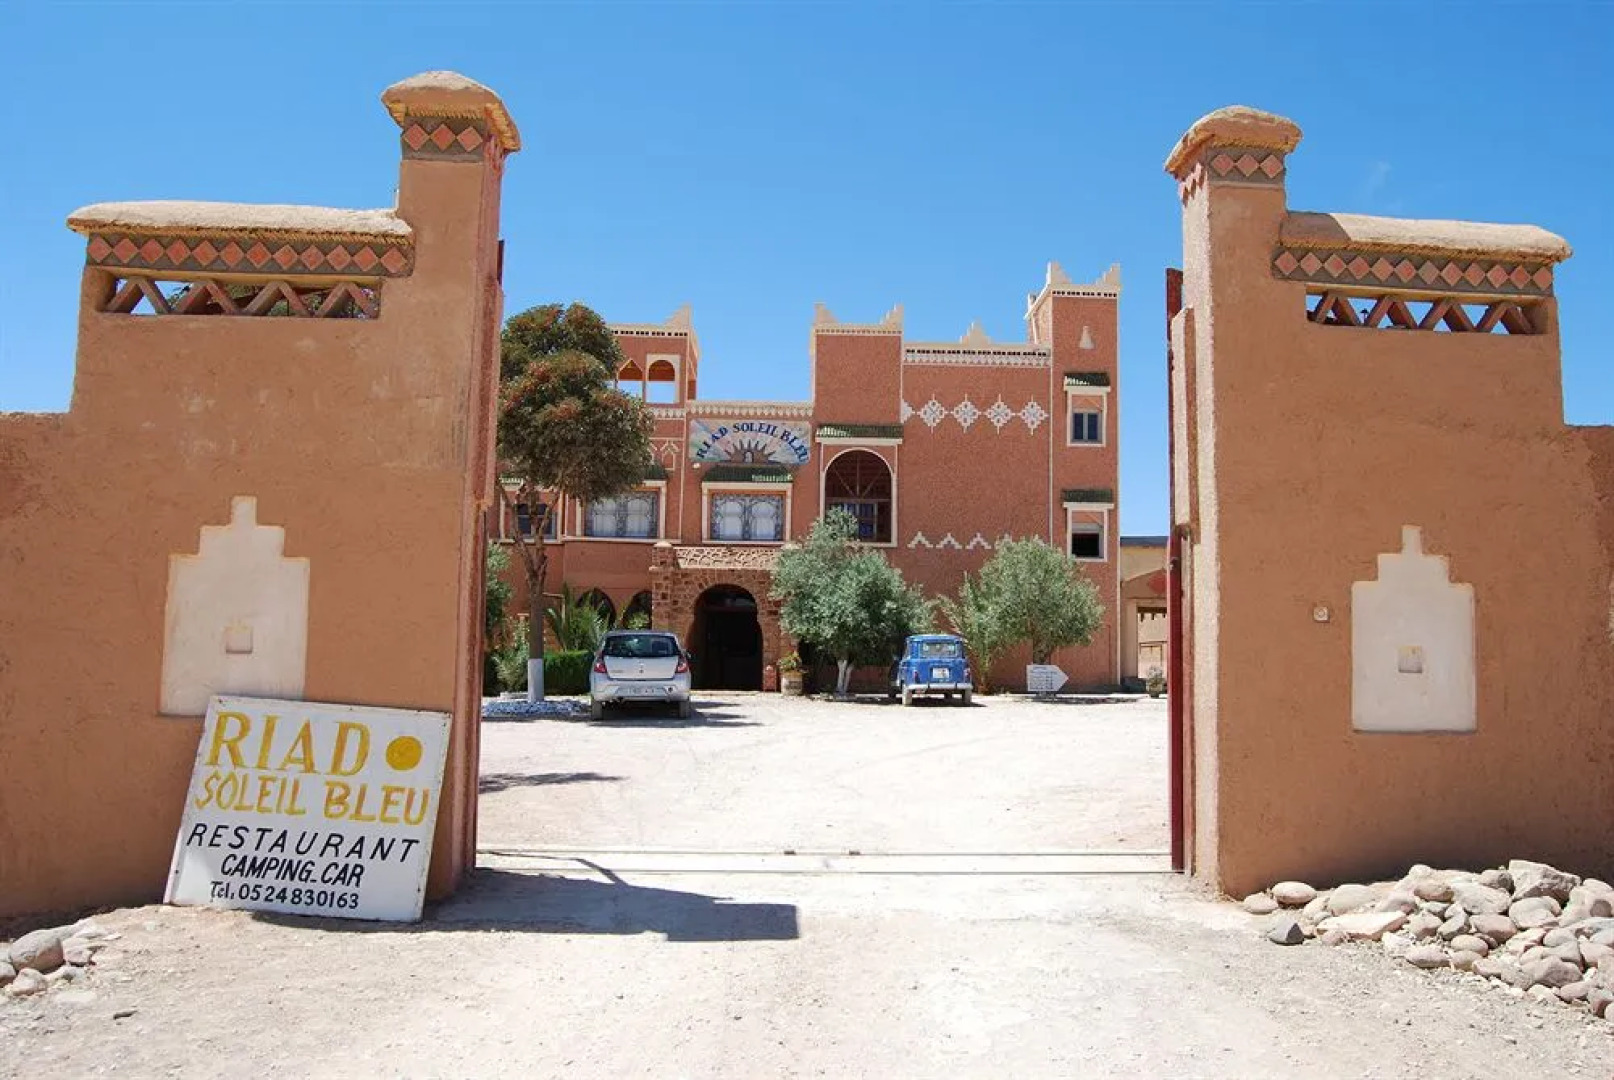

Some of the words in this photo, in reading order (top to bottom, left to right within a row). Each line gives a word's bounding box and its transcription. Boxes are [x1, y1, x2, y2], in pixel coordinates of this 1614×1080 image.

[697, 426, 728, 459] RIAD
[733, 423, 778, 436] SOLEIL
[204, 711, 371, 777] RIAD
[195, 770, 306, 815] SOLEIL
[323, 779, 430, 826] BLEU
[186, 822, 420, 863] RESTAURANT
[238, 883, 359, 909] 0524830163
